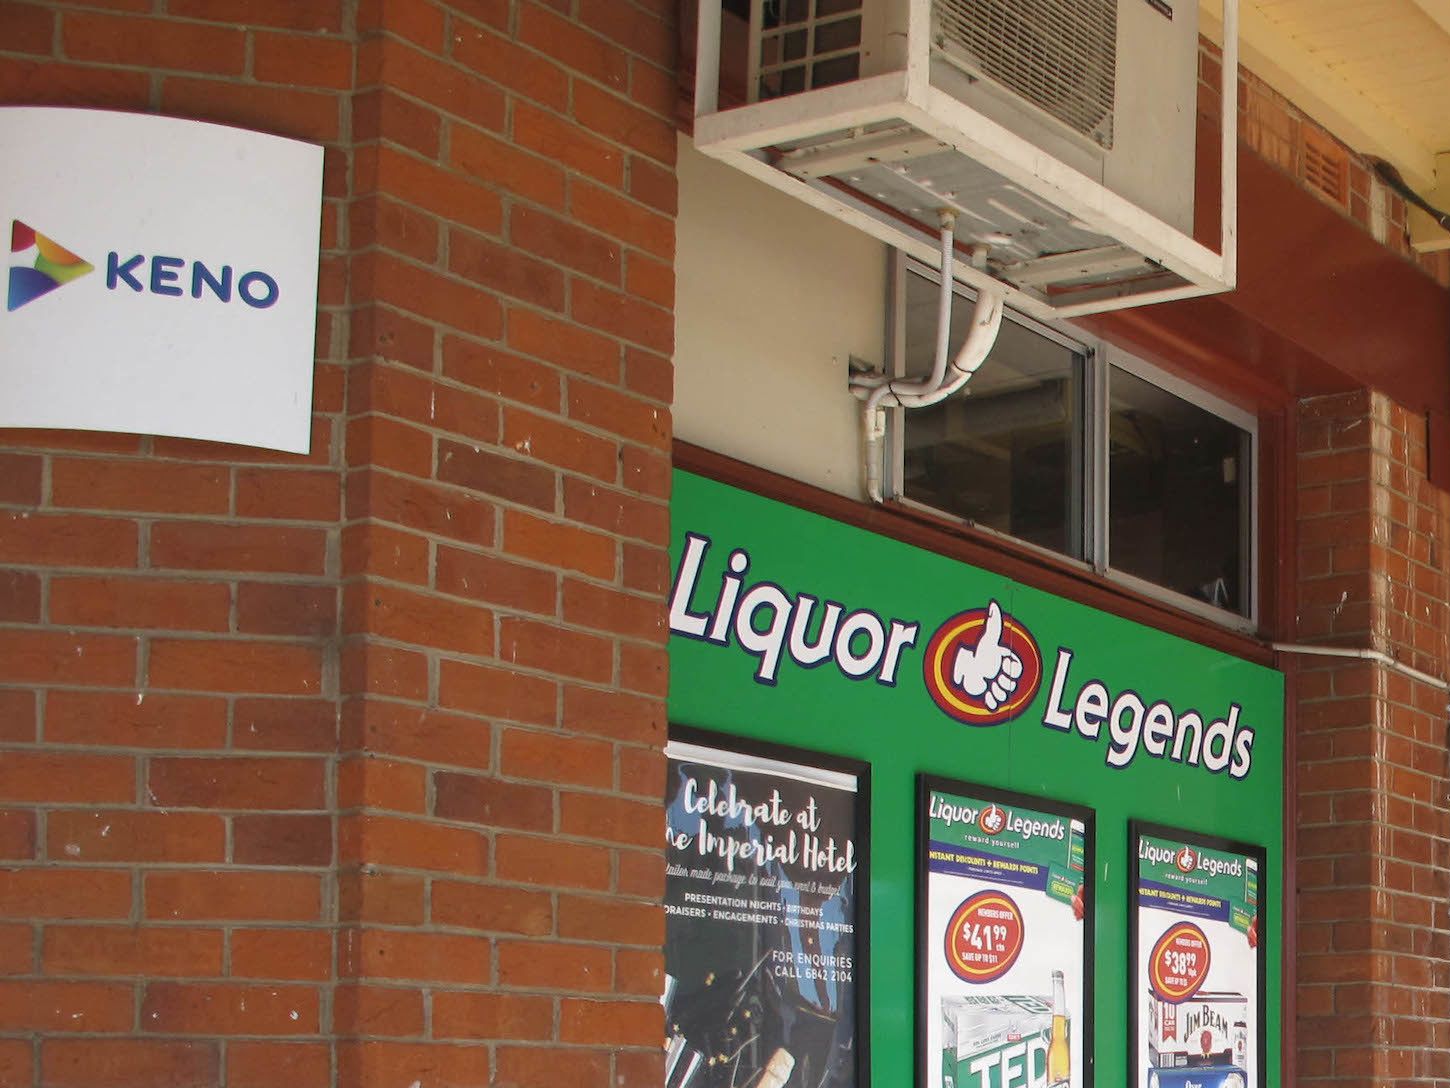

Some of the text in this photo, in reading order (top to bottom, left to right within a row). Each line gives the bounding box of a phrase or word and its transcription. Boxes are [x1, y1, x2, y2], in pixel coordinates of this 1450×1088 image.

[106, 251, 279, 309] KENO
[668, 531, 1256, 781] Liquor Legends
[684, 777, 821, 832] Celebrate at
[929, 796, 1065, 840] Liquor Legends
[666, 818, 857, 873] he Imperial Hotel
[929, 850, 954, 863] NSTANT
[964, 834, 1020, 849] reward yourself
[1138, 839, 1242, 876] Liquor Legends
[690, 868, 712, 881] made
[712, 871, 747, 890] package
[749, 873, 758, 886] to
[665, 904, 854, 934] DRAISERS ENGAGEMENTS CHRISTMAS PARTIES
[685, 892, 823, 917] PRESENTATION NIGHTS BIRTHDAYS
[772, 950, 853, 969] FOR ENQUIRIES
[774, 965, 852, 983] CALL 6842 2104
[1164, 1003, 1175, 1019] 10
[1184, 1004, 1228, 1043] JIM BEAM
